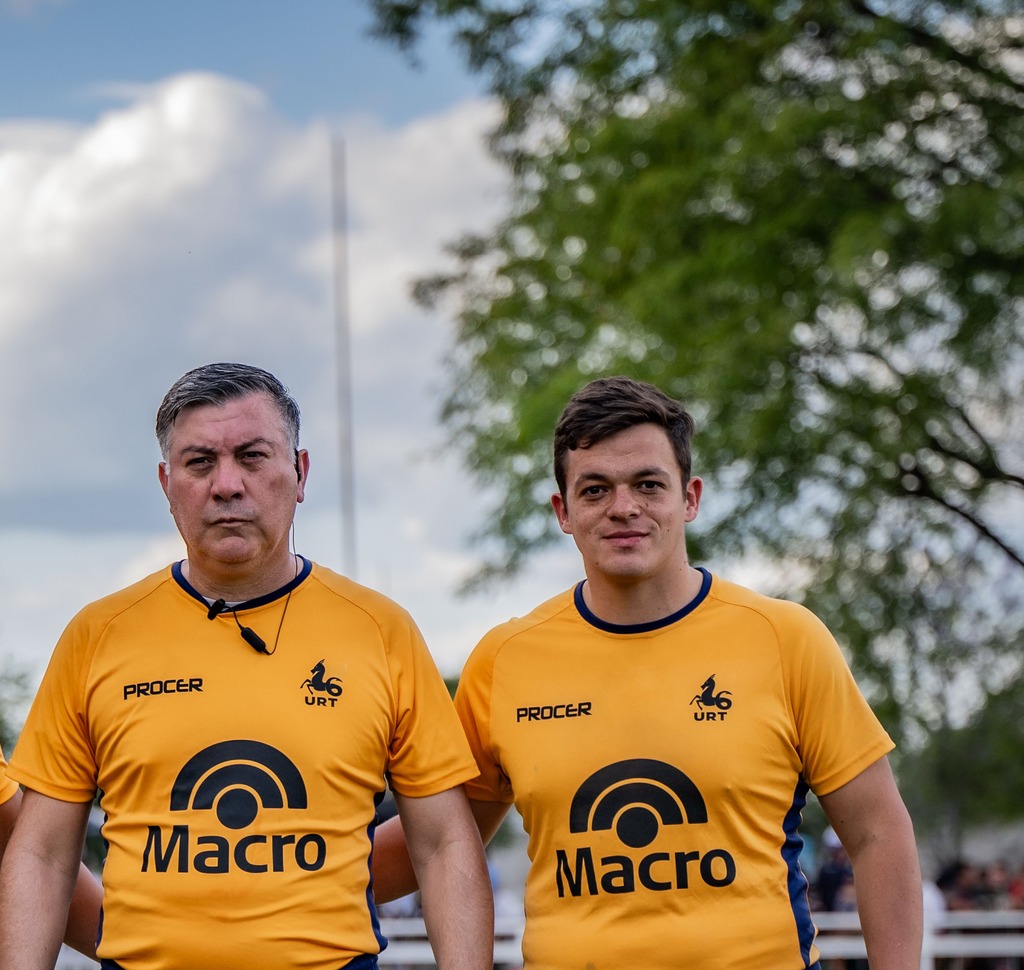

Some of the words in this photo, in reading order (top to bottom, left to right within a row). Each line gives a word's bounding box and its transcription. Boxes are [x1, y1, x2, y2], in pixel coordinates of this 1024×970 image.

[123, 678, 203, 700] PROCER
[304, 696, 337, 708] URT
[516, 701, 592, 723] PROCER
[693, 709, 727, 723] URT
[141, 825, 327, 875] Macro
[555, 847, 737, 898] Macro
